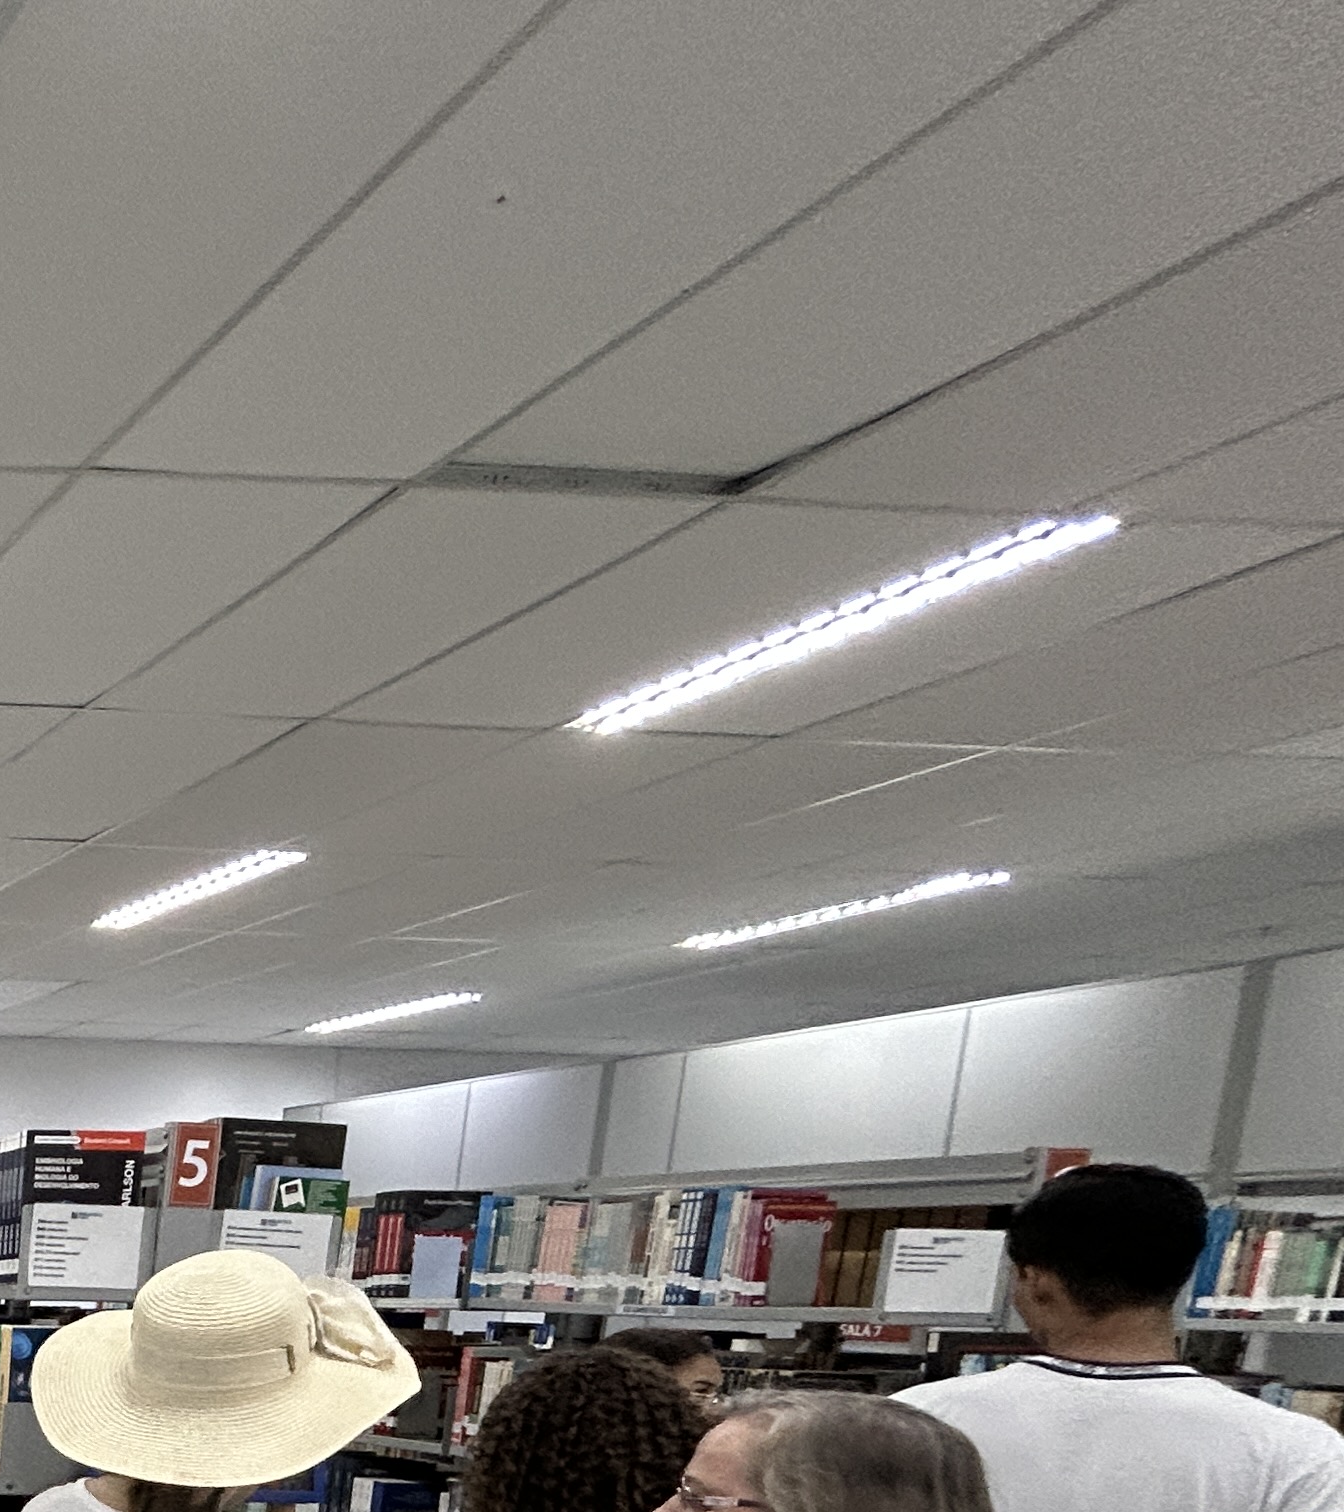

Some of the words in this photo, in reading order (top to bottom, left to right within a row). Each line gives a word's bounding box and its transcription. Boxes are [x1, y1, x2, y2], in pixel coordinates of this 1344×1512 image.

[177, 1139, 209, 1188] 5
[839, 1323, 871, 1337] SALA
[872, 1325, 883, 1337] 7
